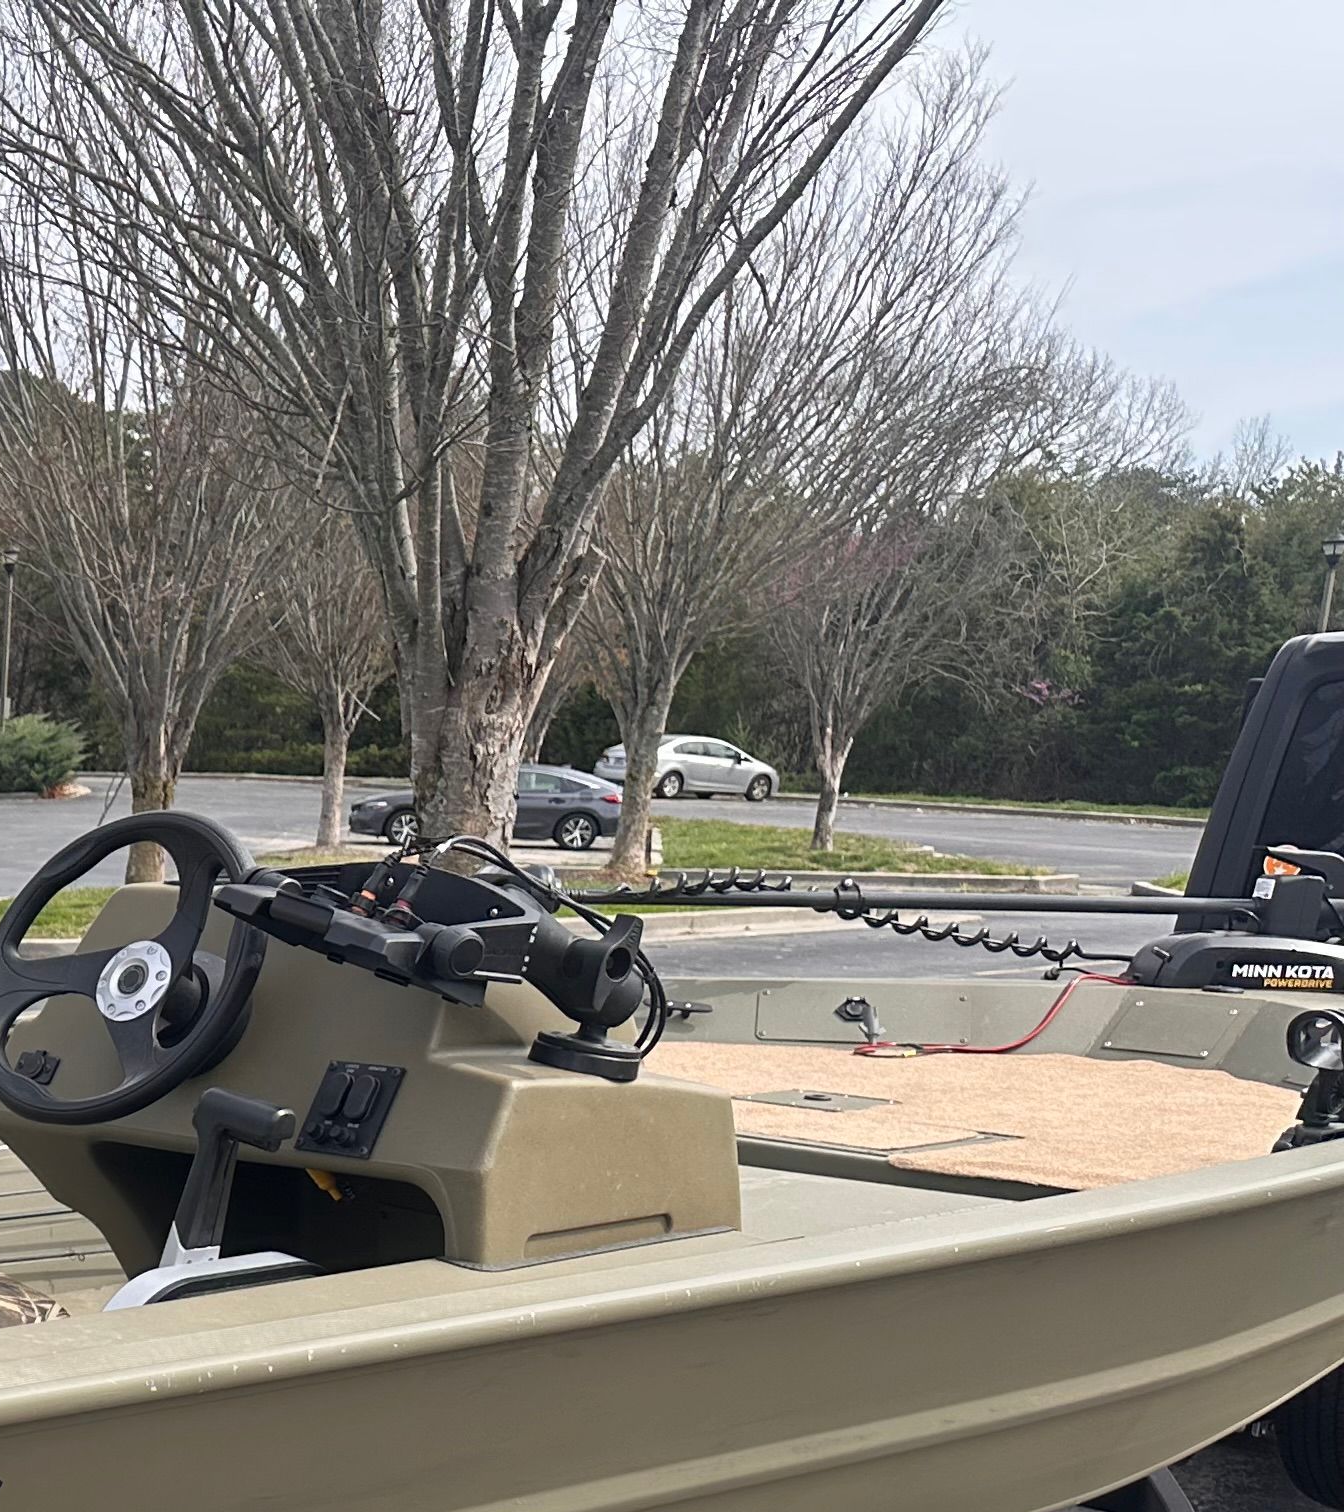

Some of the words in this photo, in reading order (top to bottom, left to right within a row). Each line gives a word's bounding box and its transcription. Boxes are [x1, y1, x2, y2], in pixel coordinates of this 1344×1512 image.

[1231, 964, 1283, 978] MINN
[1285, 965, 1334, 979] KOTA
[1263, 979, 1333, 988] POWERDRIVE
